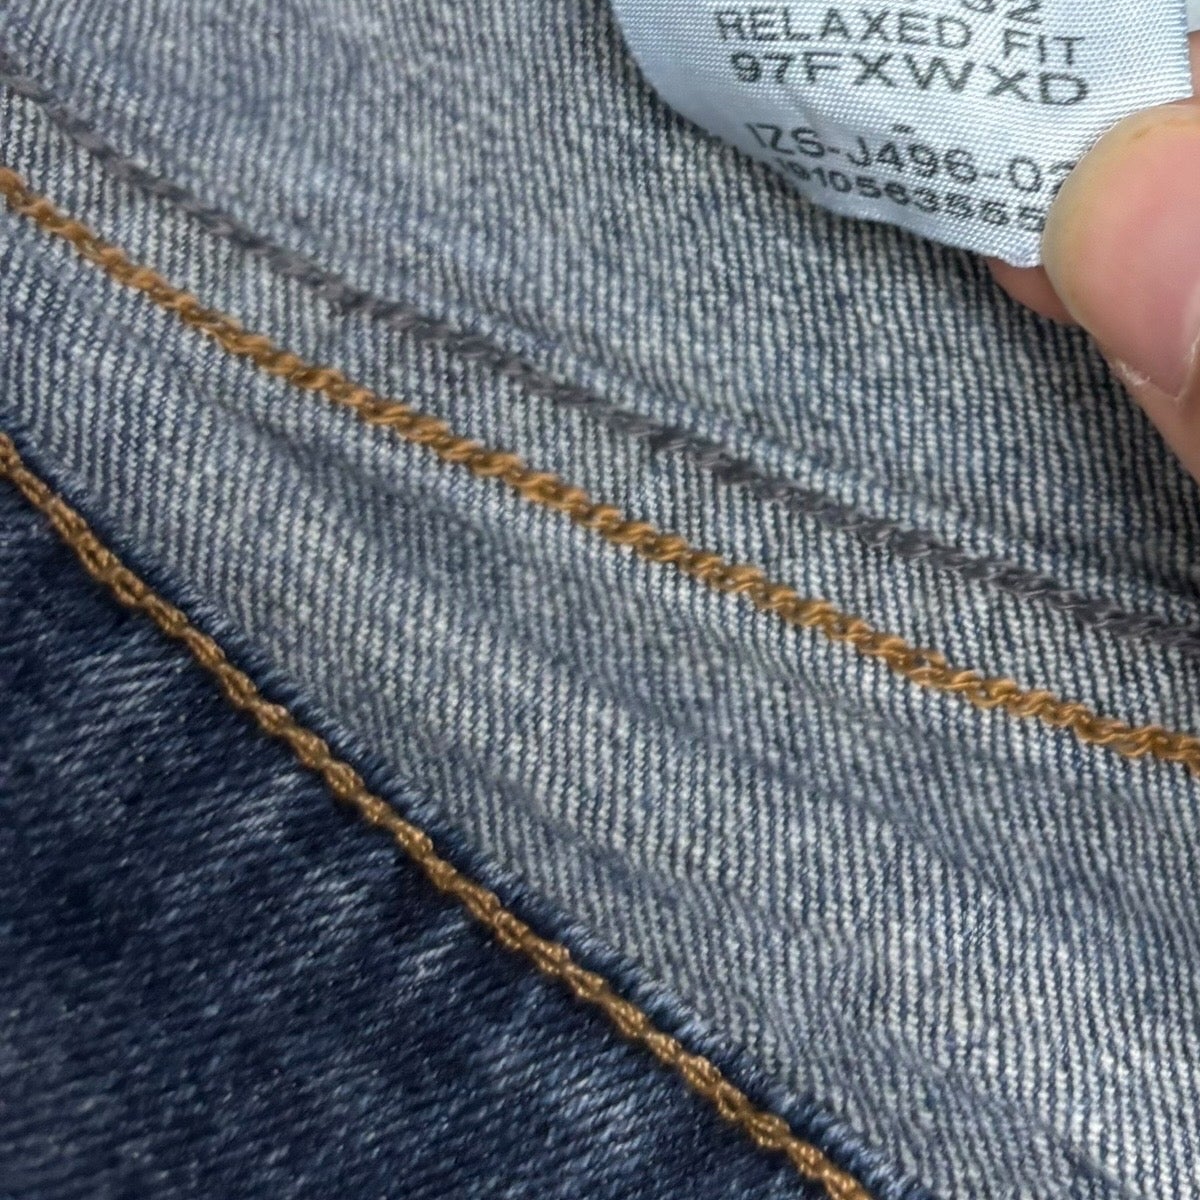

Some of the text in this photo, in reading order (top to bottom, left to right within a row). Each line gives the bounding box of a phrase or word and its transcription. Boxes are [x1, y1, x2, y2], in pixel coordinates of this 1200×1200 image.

[714, 6, 1086, 67] RELAXED FIT
[730, 51, 1088, 105] 97FXWXD
